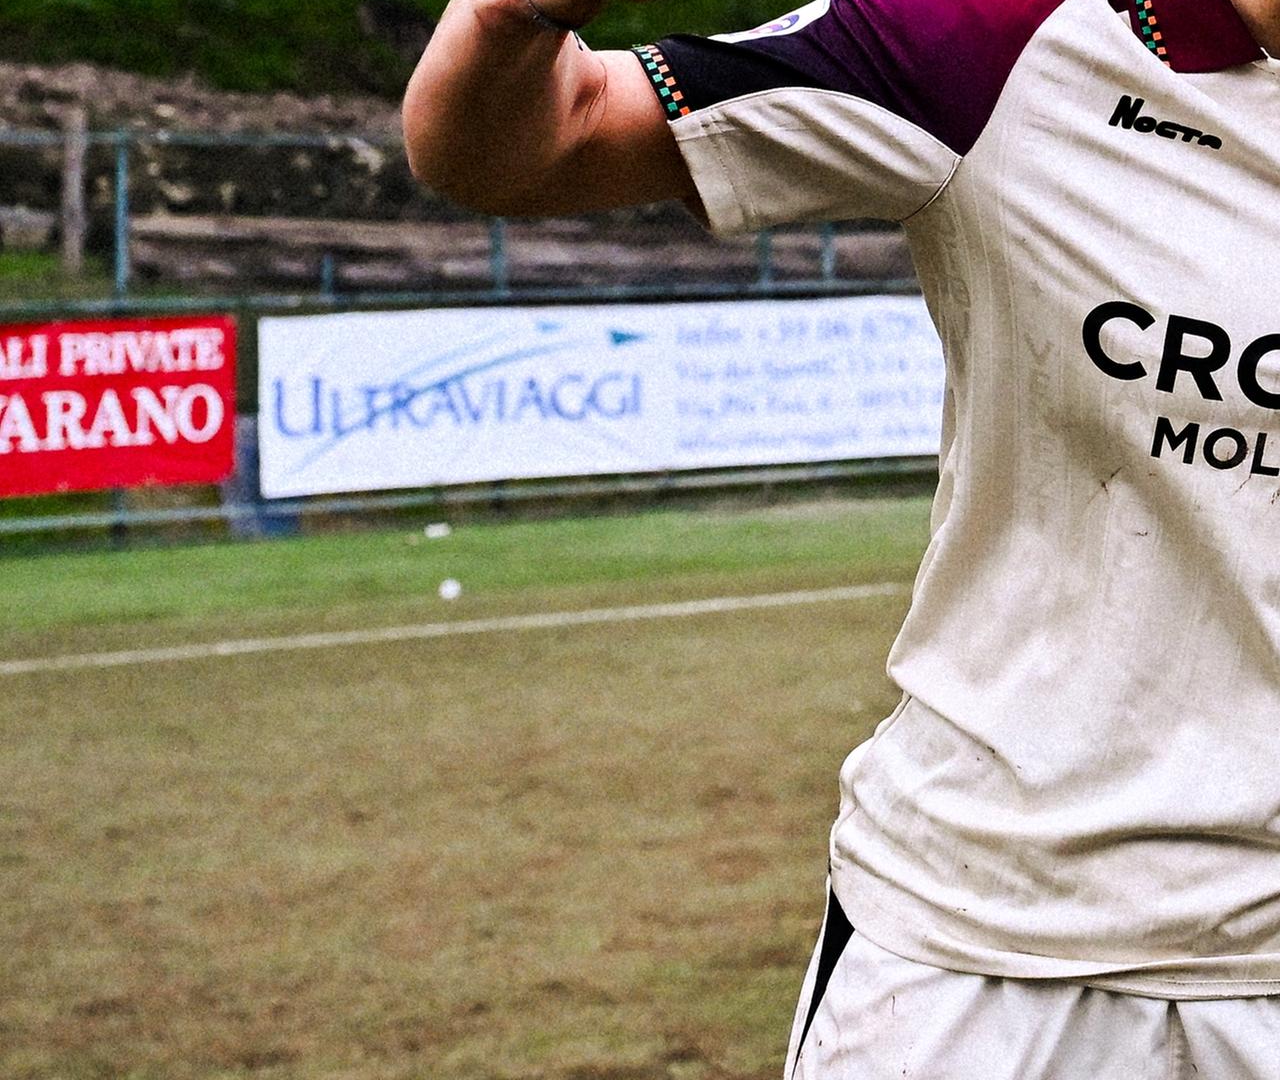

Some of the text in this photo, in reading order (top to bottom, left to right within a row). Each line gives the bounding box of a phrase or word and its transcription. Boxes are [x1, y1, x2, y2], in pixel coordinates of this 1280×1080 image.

[0, 327, 225, 381] LI PRIVATE
[0, 383, 225, 454] ARANO
